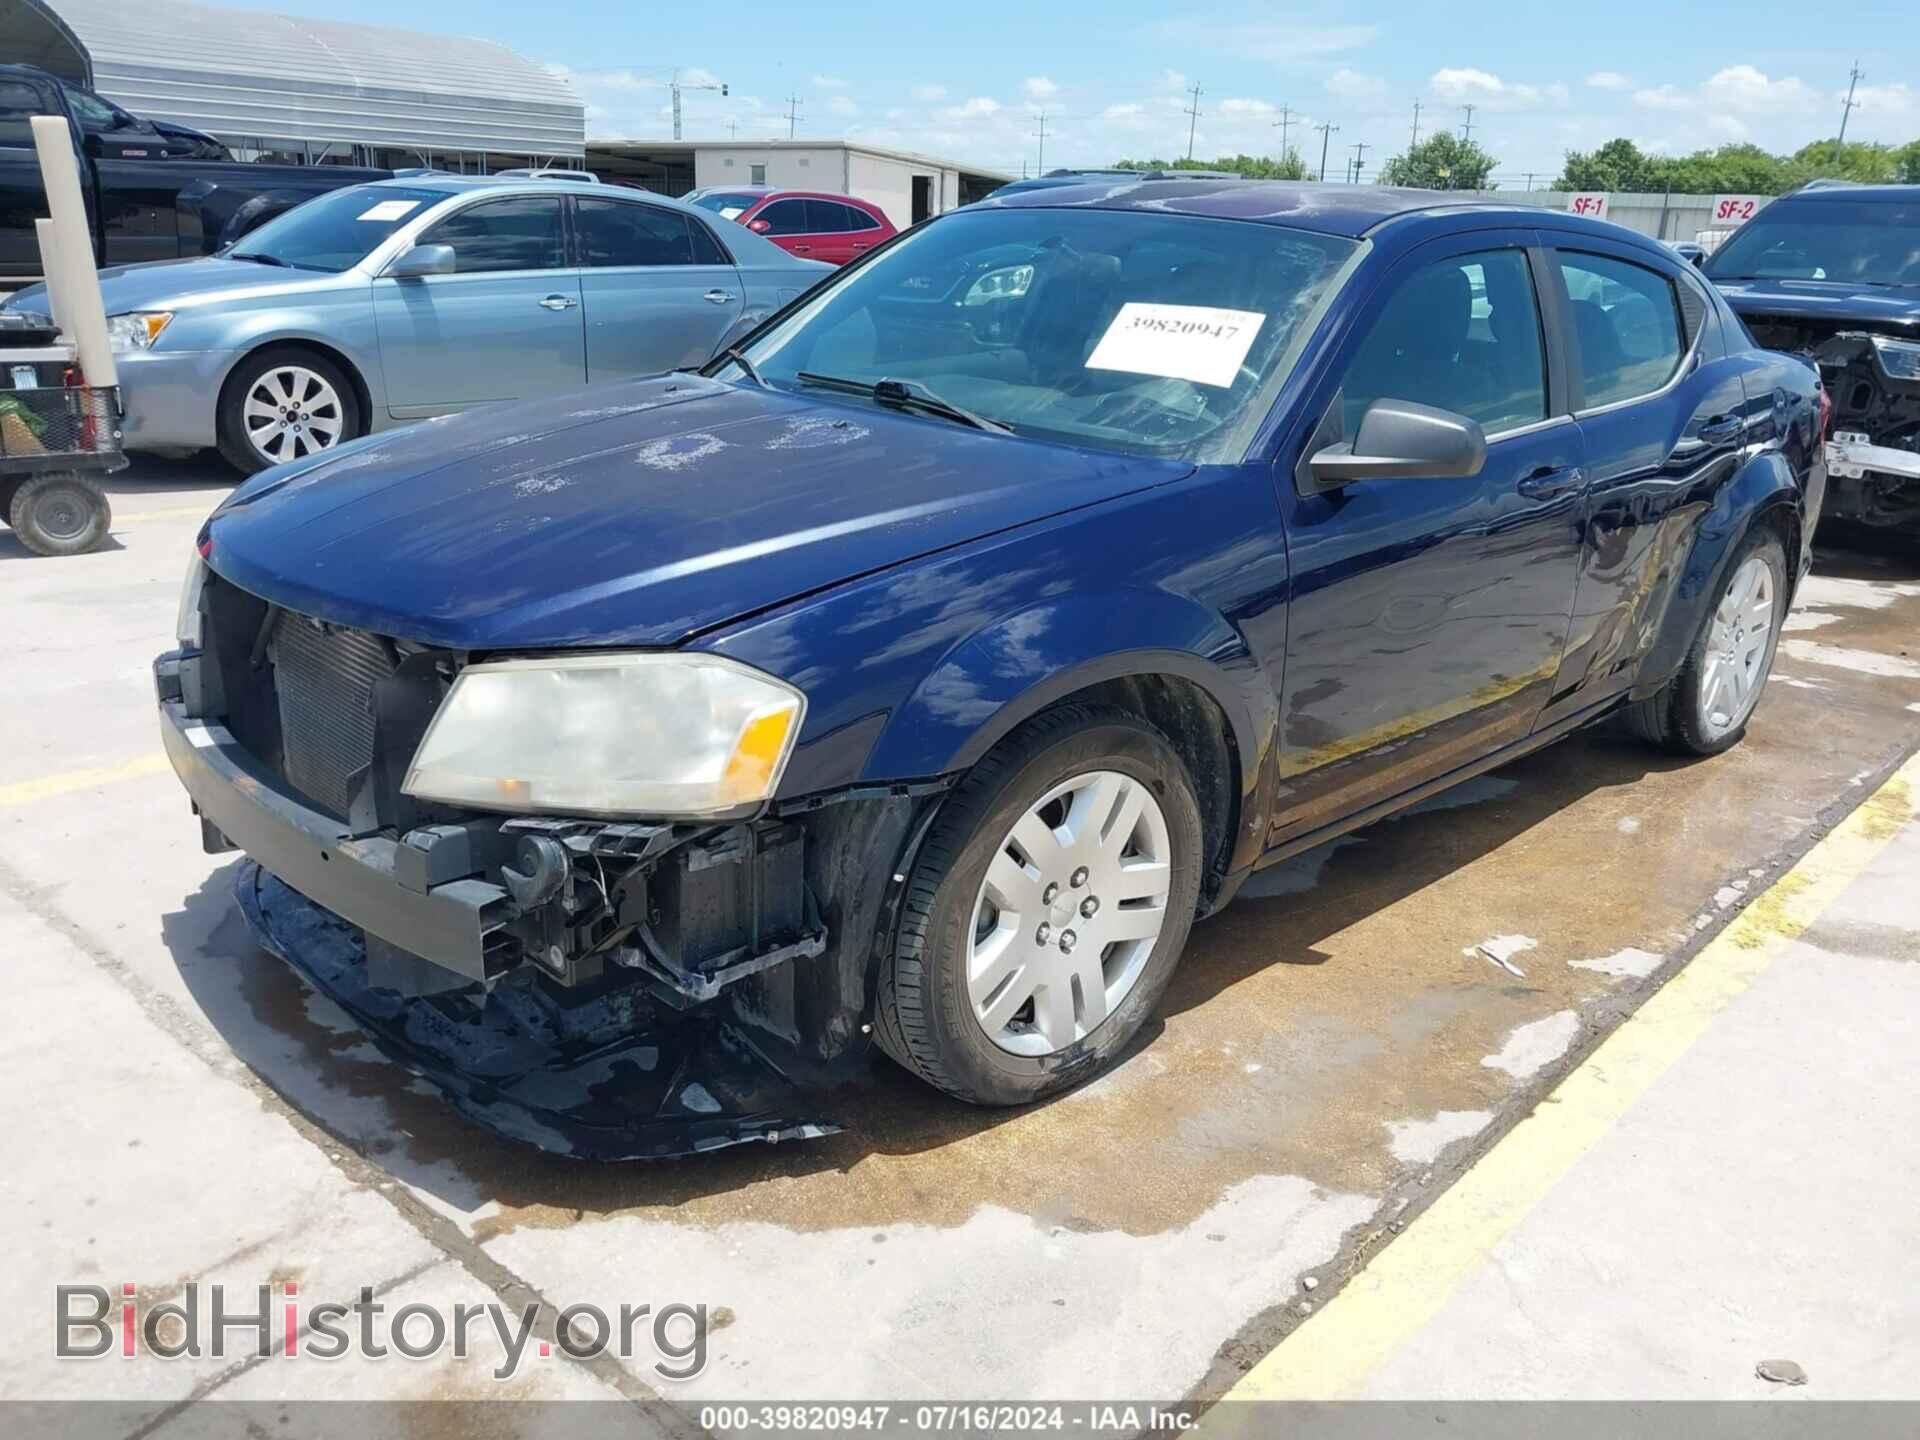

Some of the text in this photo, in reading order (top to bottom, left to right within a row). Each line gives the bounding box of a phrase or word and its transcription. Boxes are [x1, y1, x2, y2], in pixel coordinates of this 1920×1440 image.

[1572, 197, 1604, 216] SF-1
[1717, 200, 1754, 219] SF-2
[1124, 316, 1240, 340] 39820947
